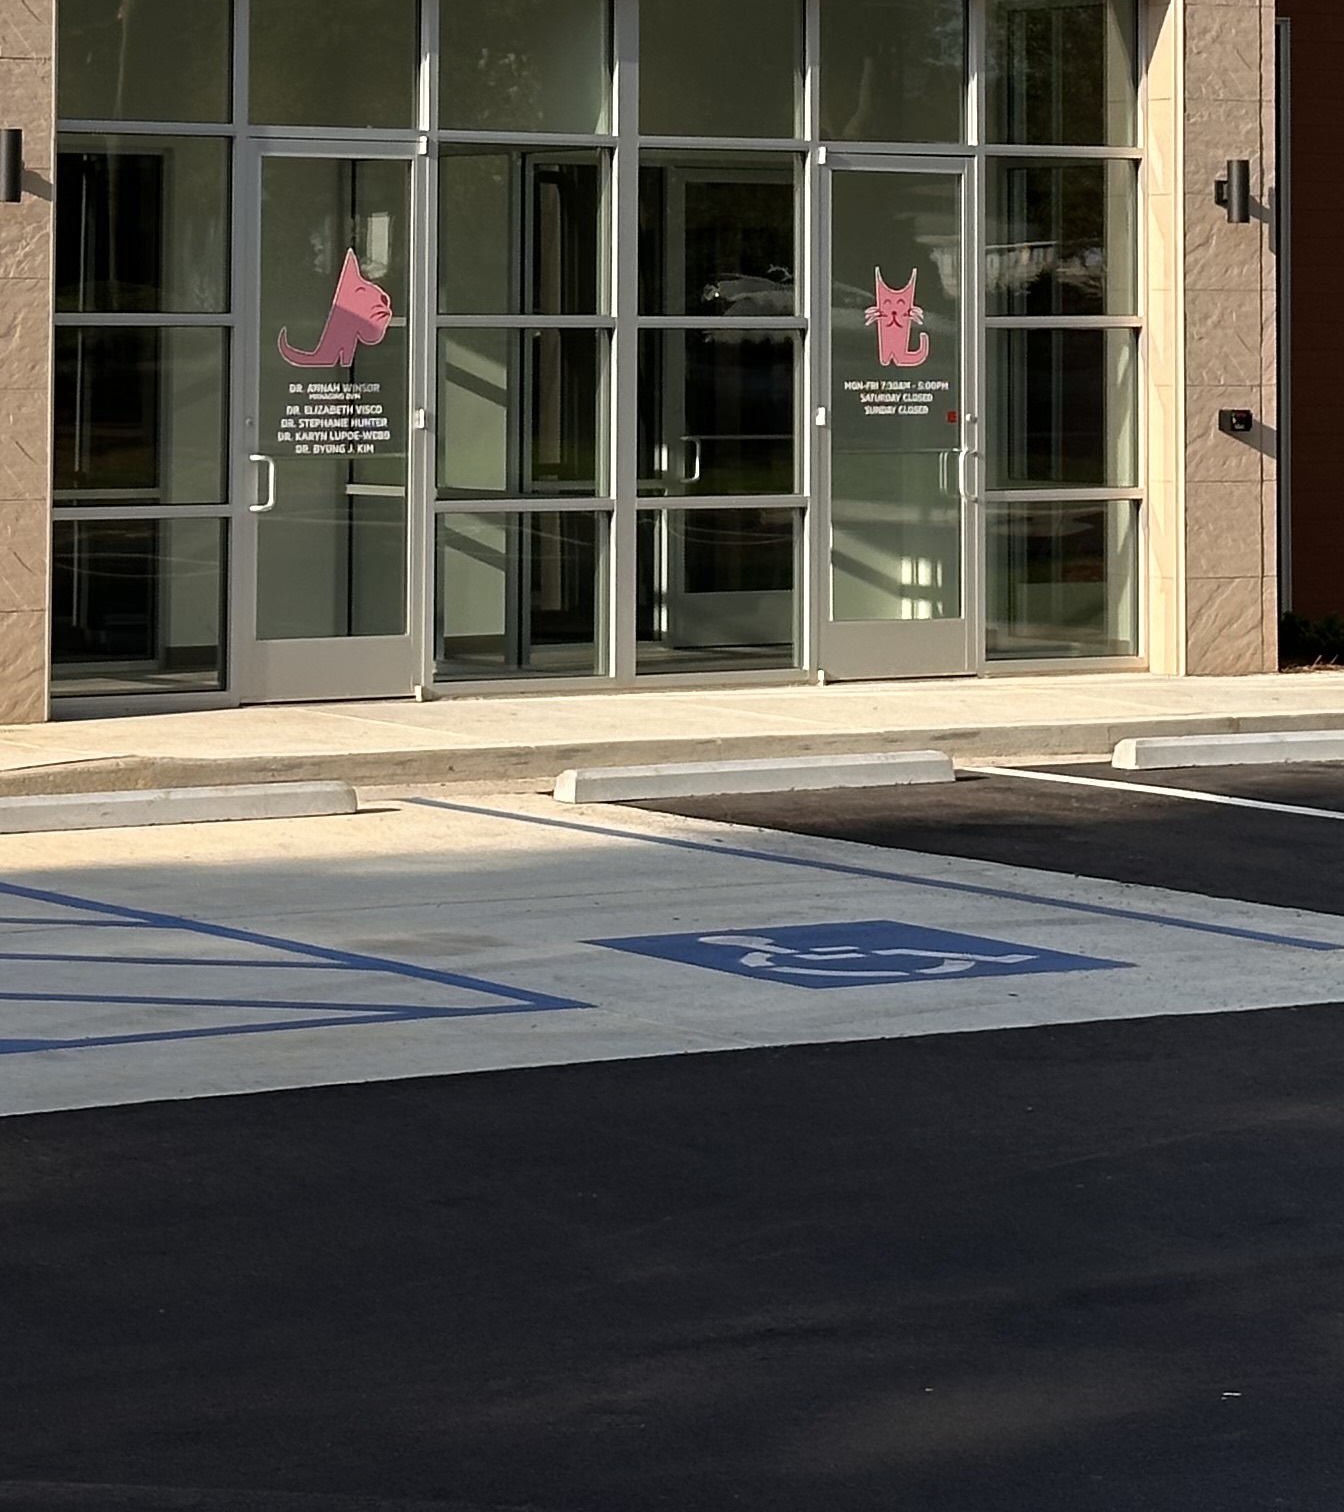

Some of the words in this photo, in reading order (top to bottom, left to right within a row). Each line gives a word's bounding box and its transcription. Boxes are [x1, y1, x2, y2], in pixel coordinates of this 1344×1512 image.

[288, 382, 305, 393] DR.
[342, 382, 381, 393] WINSOR
[859, 393, 902, 403] SATURDAY
[902, 393, 934, 403] CLOSED
[285, 405, 302, 416] DR.
[303, 404, 354, 415] ELIZABETH
[354, 404, 383, 415] VISCO
[864, 405, 897, 415] SUNDAY
[897, 405, 930, 415] CLOSED
[280, 418, 296, 428] DR.
[298, 418, 349, 428] STEPHANIE
[350, 417, 388, 428] HUNTER
[277, 431, 294, 442] DR.
[295, 444, 311, 454] DR.
[312, 444, 346, 454] BYUNG
[356, 444, 375, 454] KIM
